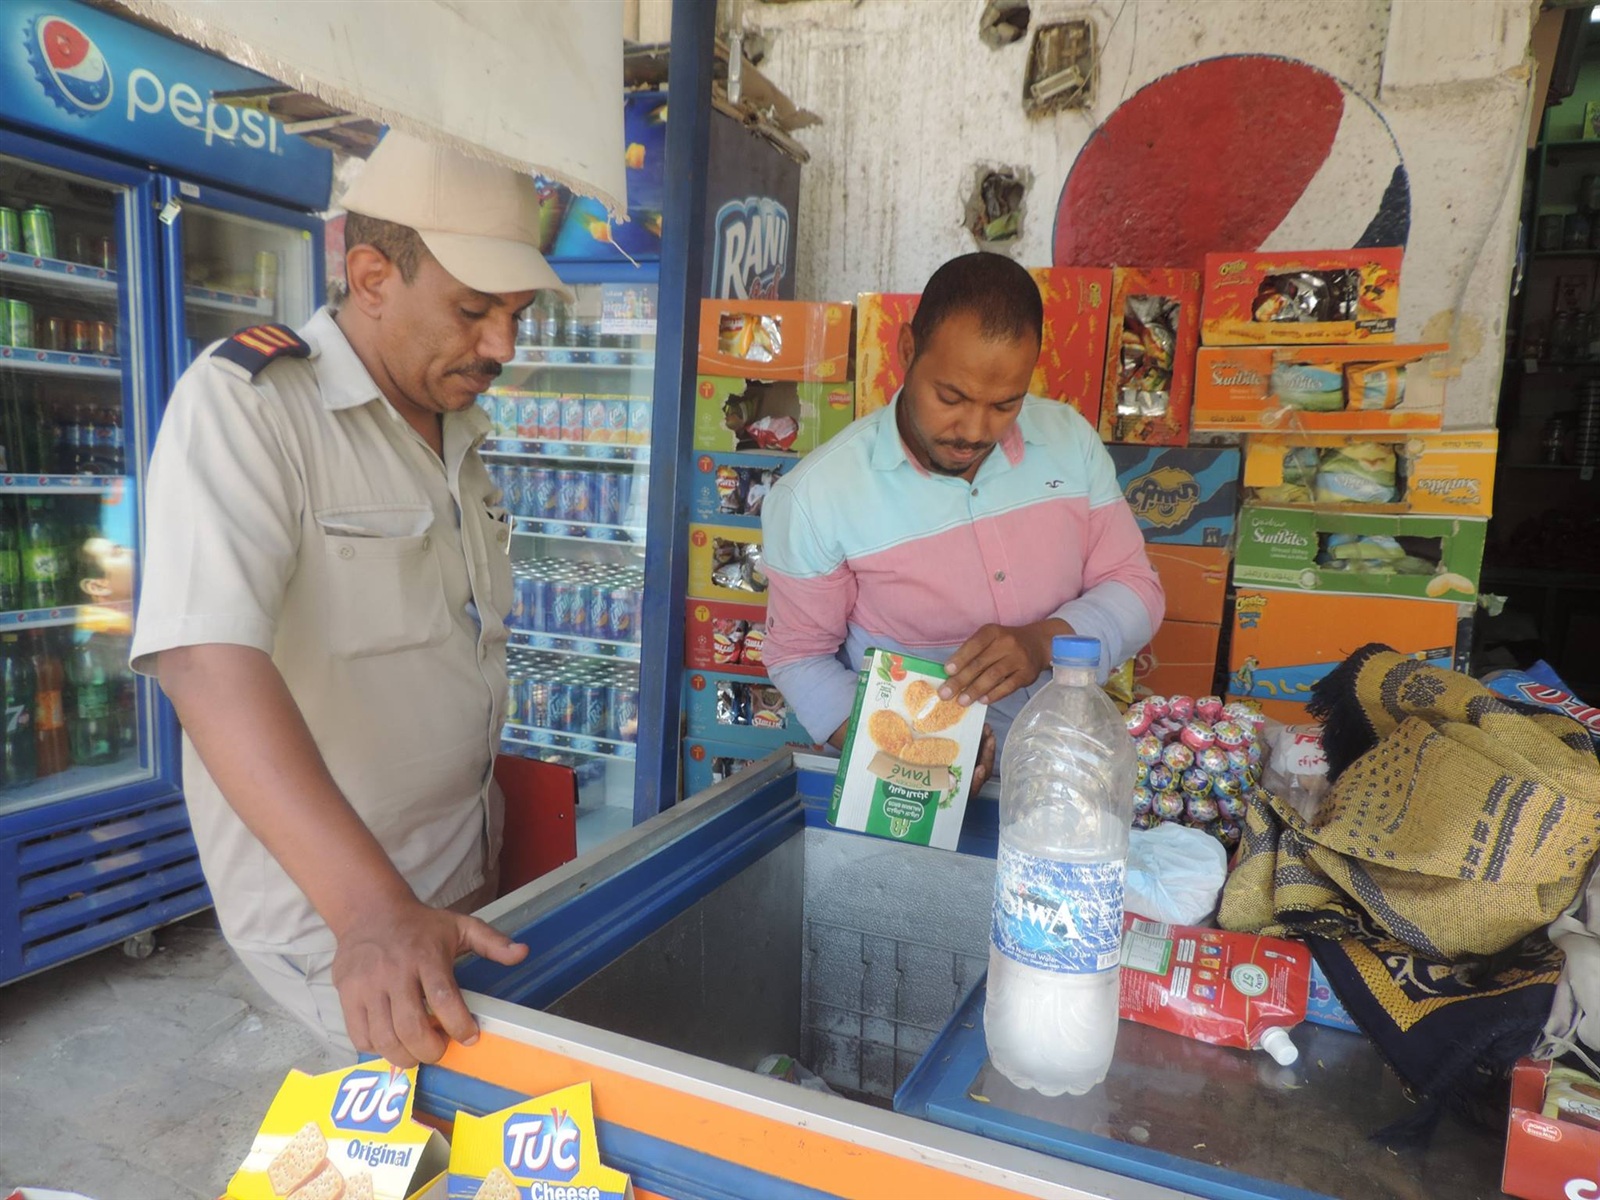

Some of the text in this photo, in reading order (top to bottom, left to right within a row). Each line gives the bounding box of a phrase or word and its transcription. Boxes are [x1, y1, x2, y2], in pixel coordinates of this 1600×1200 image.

[127, 68, 278, 154] pepsi
[721, 213, 787, 299] RANI
[1254, 528, 1308, 546] SunBites
[335, 1075, 409, 1124] TUC
[346, 1138, 413, 1168] Original
[506, 1120, 579, 1171] TUC
[530, 1181, 600, 1200] Cheese
